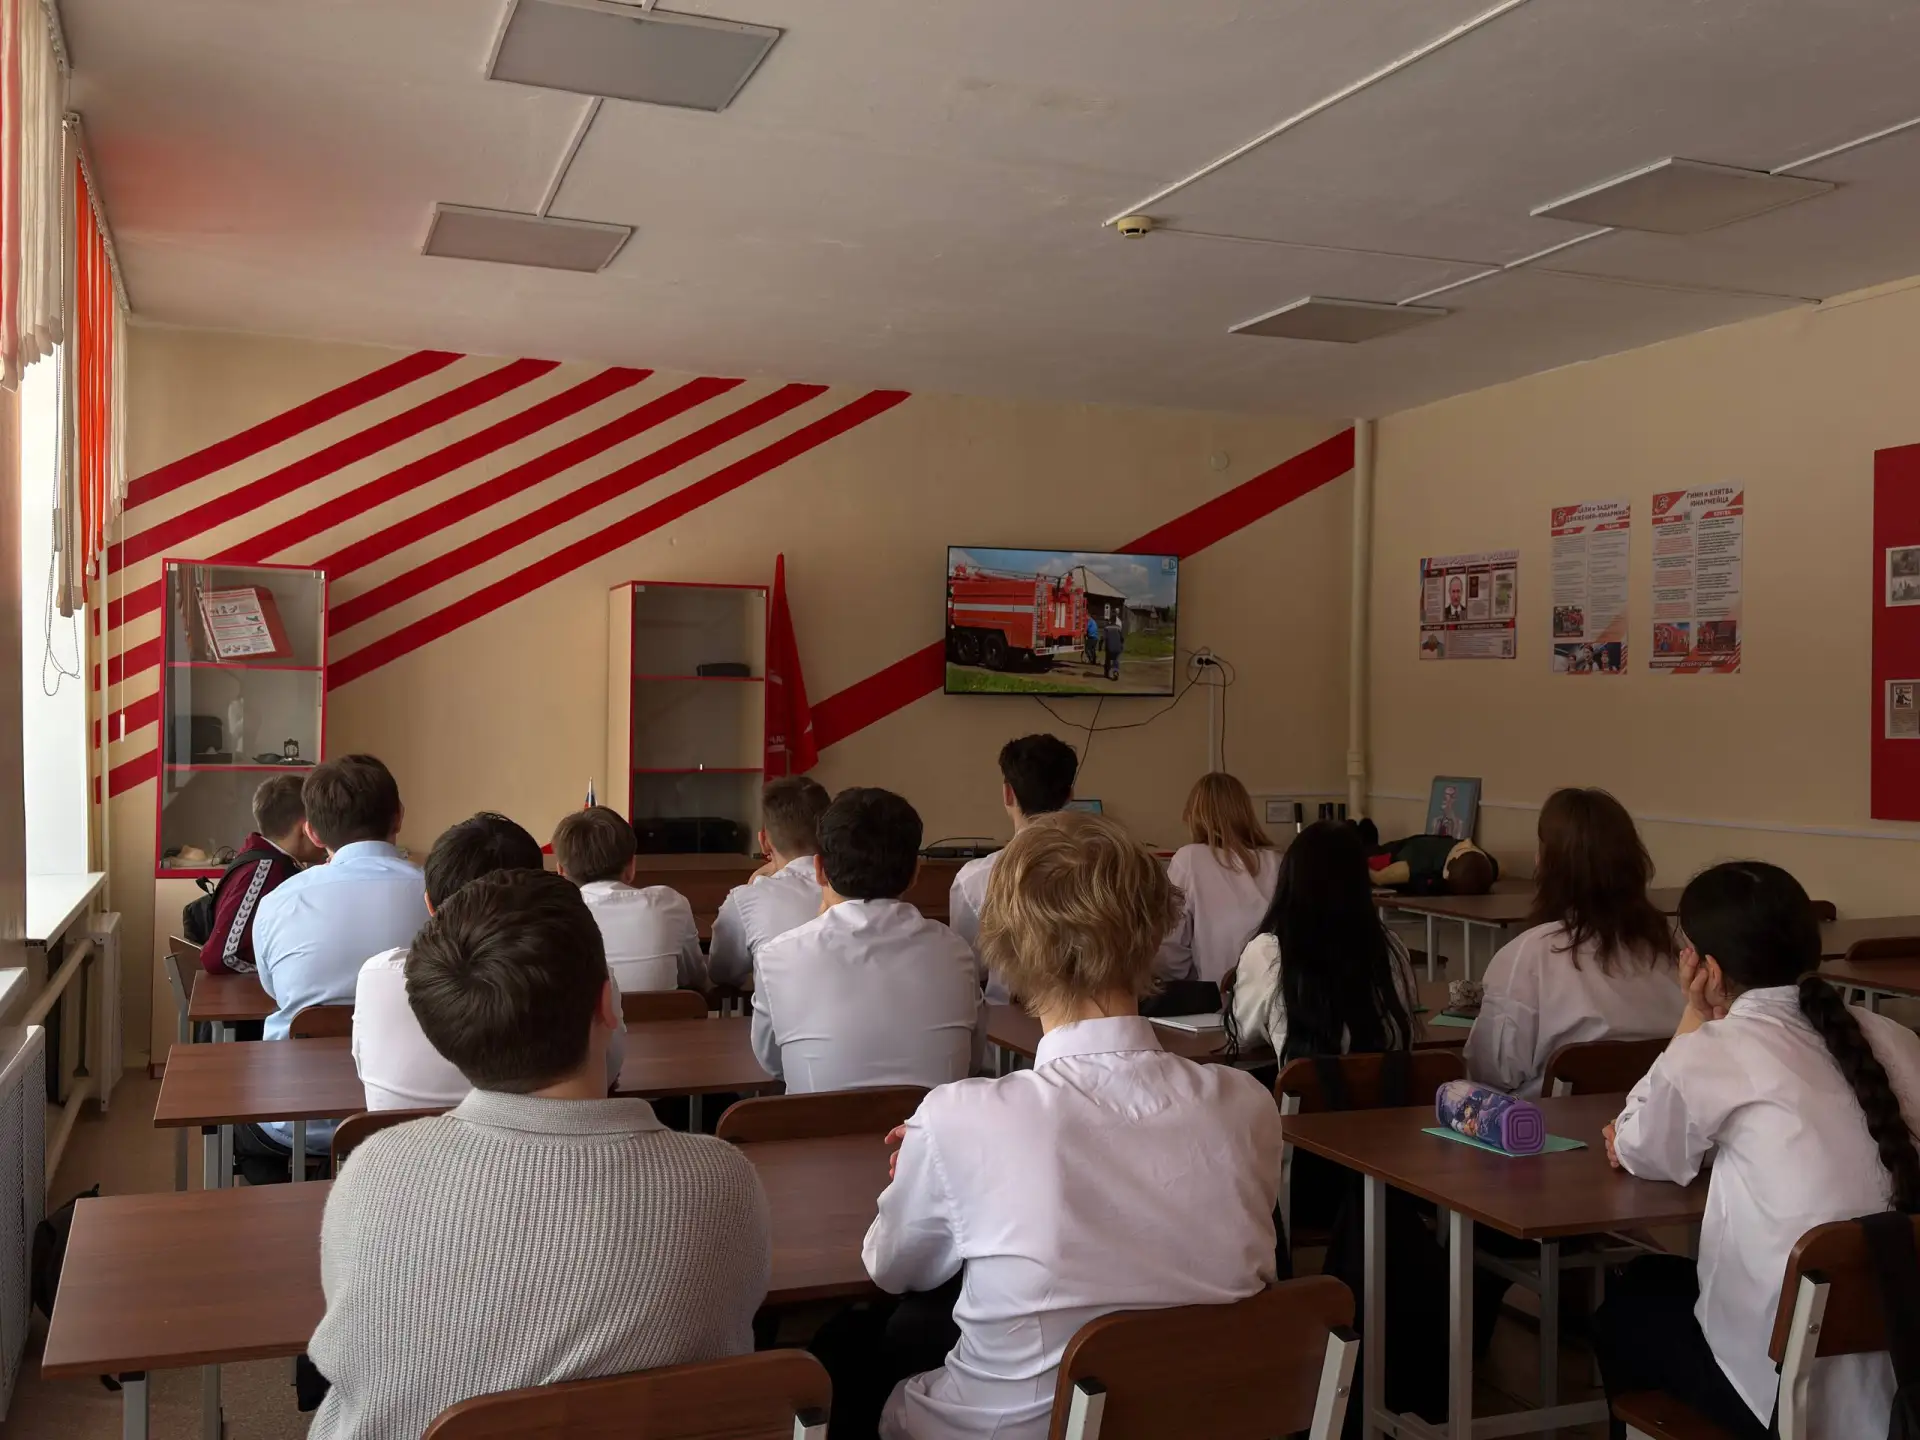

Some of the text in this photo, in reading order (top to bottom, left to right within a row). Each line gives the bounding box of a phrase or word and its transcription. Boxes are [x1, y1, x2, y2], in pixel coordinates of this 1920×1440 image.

[1709, 487, 1734, 496] КЛЯТВА
[1690, 495, 1729, 507] ЮНАРМЕЙЦА
[1596, 503, 1618, 512] ЗАДАЧИ
